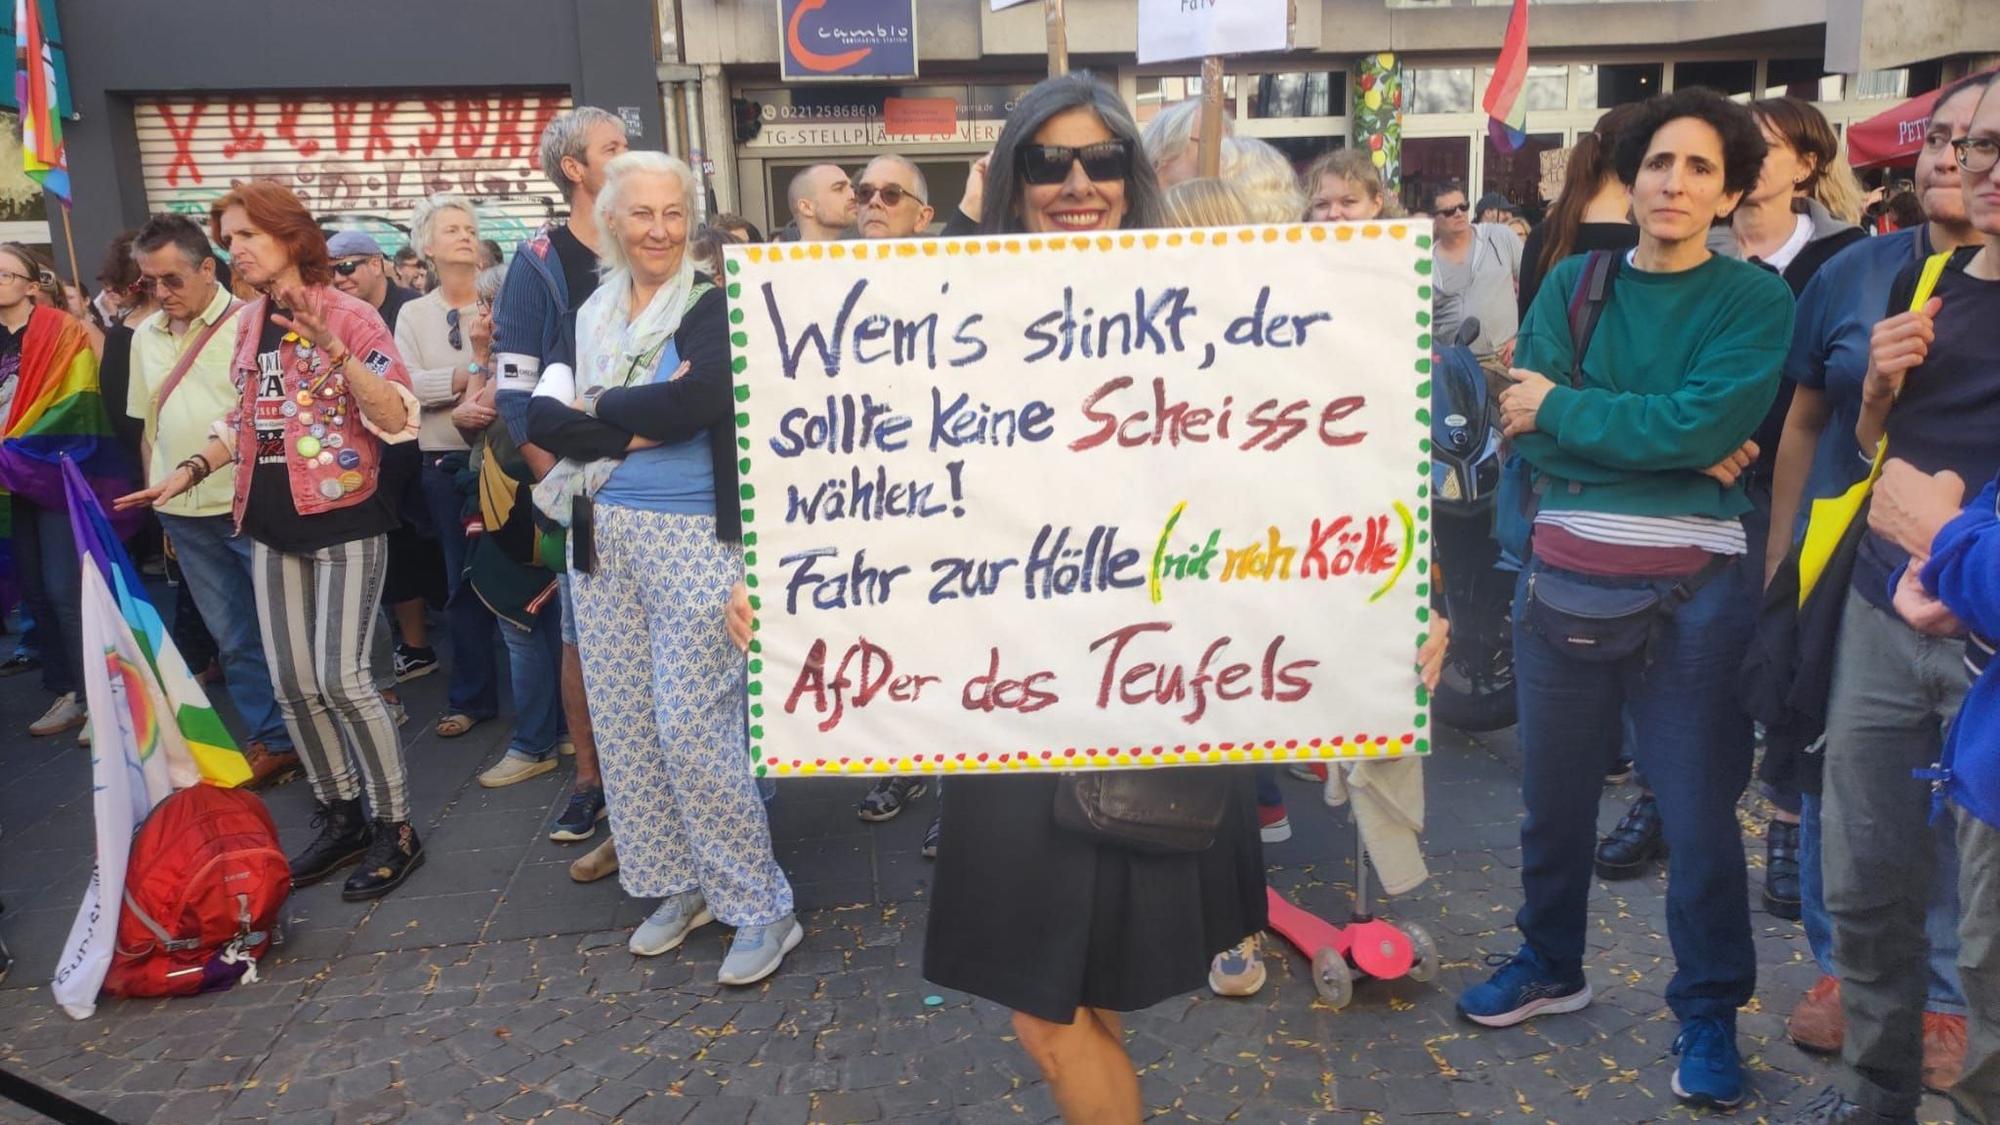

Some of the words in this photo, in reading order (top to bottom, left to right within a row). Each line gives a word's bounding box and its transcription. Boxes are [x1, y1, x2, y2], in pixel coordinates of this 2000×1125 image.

[780, 105, 812, 118] 0221
[761, 278, 988, 379] Wem's
[1023, 285, 1216, 370] stinkt,
[1223, 286, 1332, 348] der
[769, 393, 913, 458] sollte
[1067, 376, 1368, 453] Scheisse
[785, 460, 966, 525] wählen!
[778, 547, 911, 615] Fahr
[928, 556, 1019, 604] zur
[1025, 524, 1146, 600] Hölle
[784, 636, 942, 732] AfDer
[961, 647, 1060, 714] des
[1089, 621, 1321, 725] Teufels
